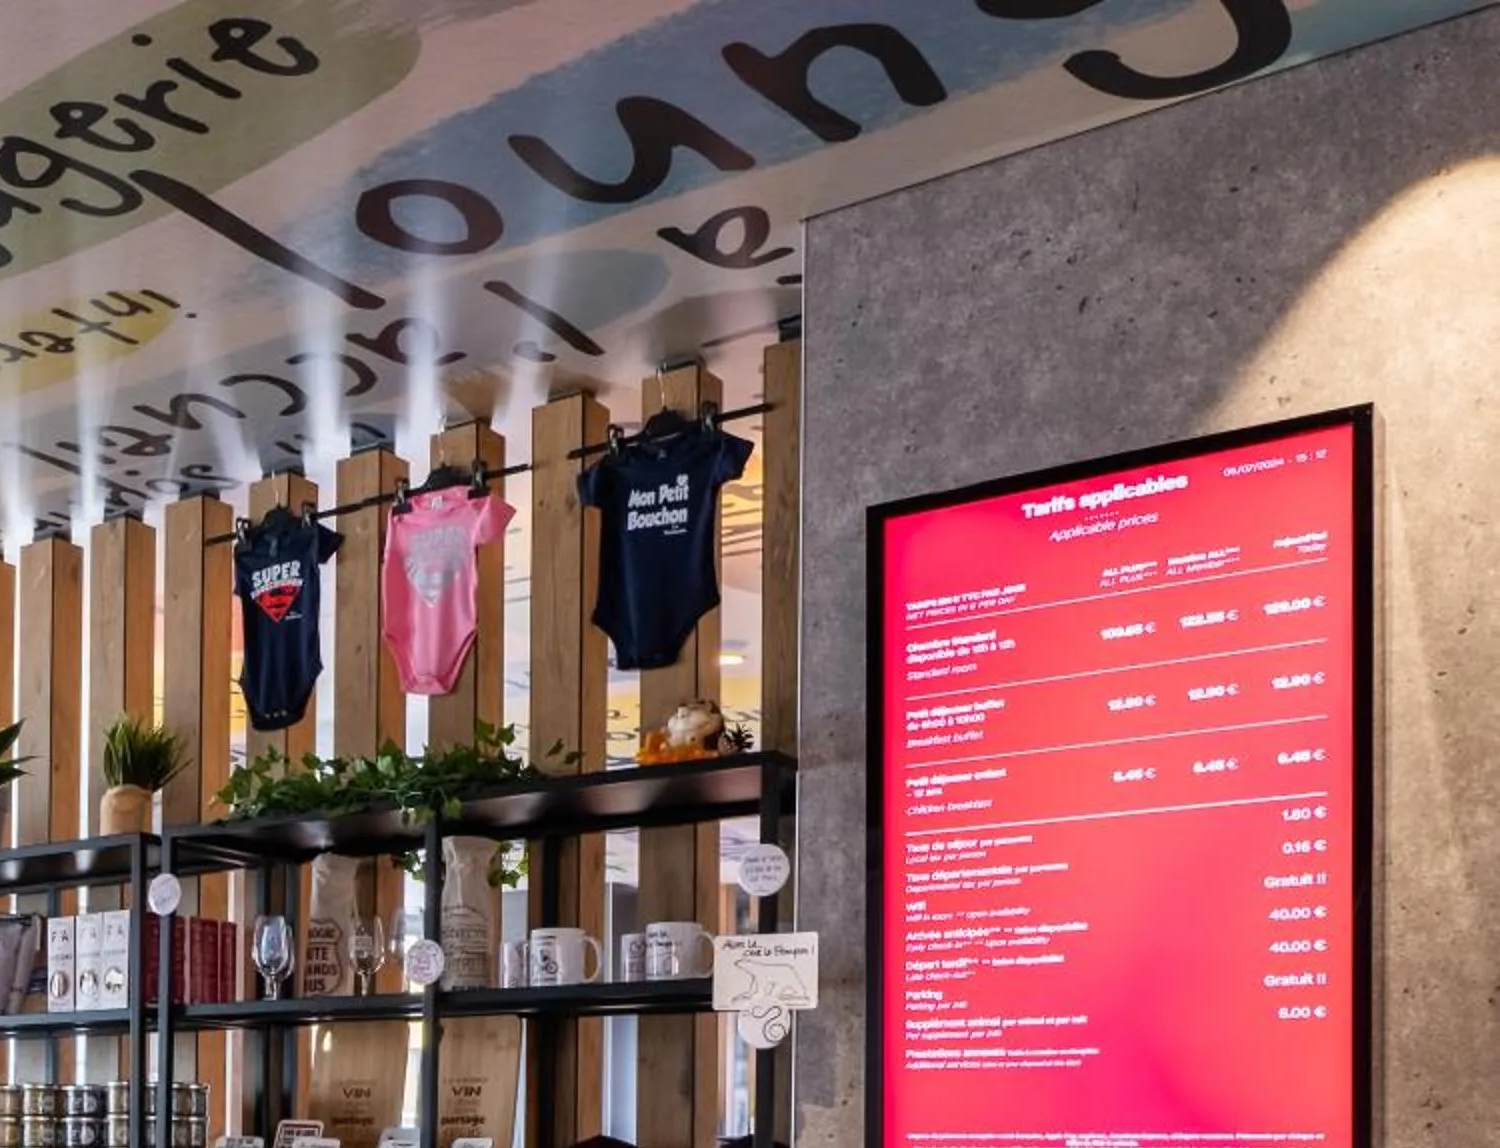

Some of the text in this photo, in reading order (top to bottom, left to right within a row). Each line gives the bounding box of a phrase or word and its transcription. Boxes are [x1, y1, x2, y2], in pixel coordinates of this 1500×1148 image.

[628, 480, 689, 508] Mon Petit
[1021, 475, 1188, 518] Tarifs applicables
[628, 506, 688, 530] Bouchon
[1049, 512, 1158, 542] Applicable prices
[251, 560, 301, 588] SUPER
[1313, 595, 1325, 607] €
[1226, 609, 1238, 621] €
[1146, 622, 1155, 633] €
[951, 663, 977, 674] room
[1313, 671, 1325, 684] €
[1226, 683, 1238, 695] €
[1145, 695, 1156, 706] €
[1313, 748, 1326, 761] €
[1145, 767, 1156, 779] €
[1314, 806, 1327, 818] €
[1313, 839, 1327, 851] €
[1264, 873, 1313, 888] Gratuit
[1268, 906, 1326, 921] 40.00 €
[1269, 939, 1327, 953] 40.00 €
[1263, 973, 1314, 987] Gratuit
[905, 990, 943, 1001] Parking
[1313, 1005, 1326, 1018] €
[343, 1087, 371, 1098] VIN
[452, 1085, 482, 1097] VIN
